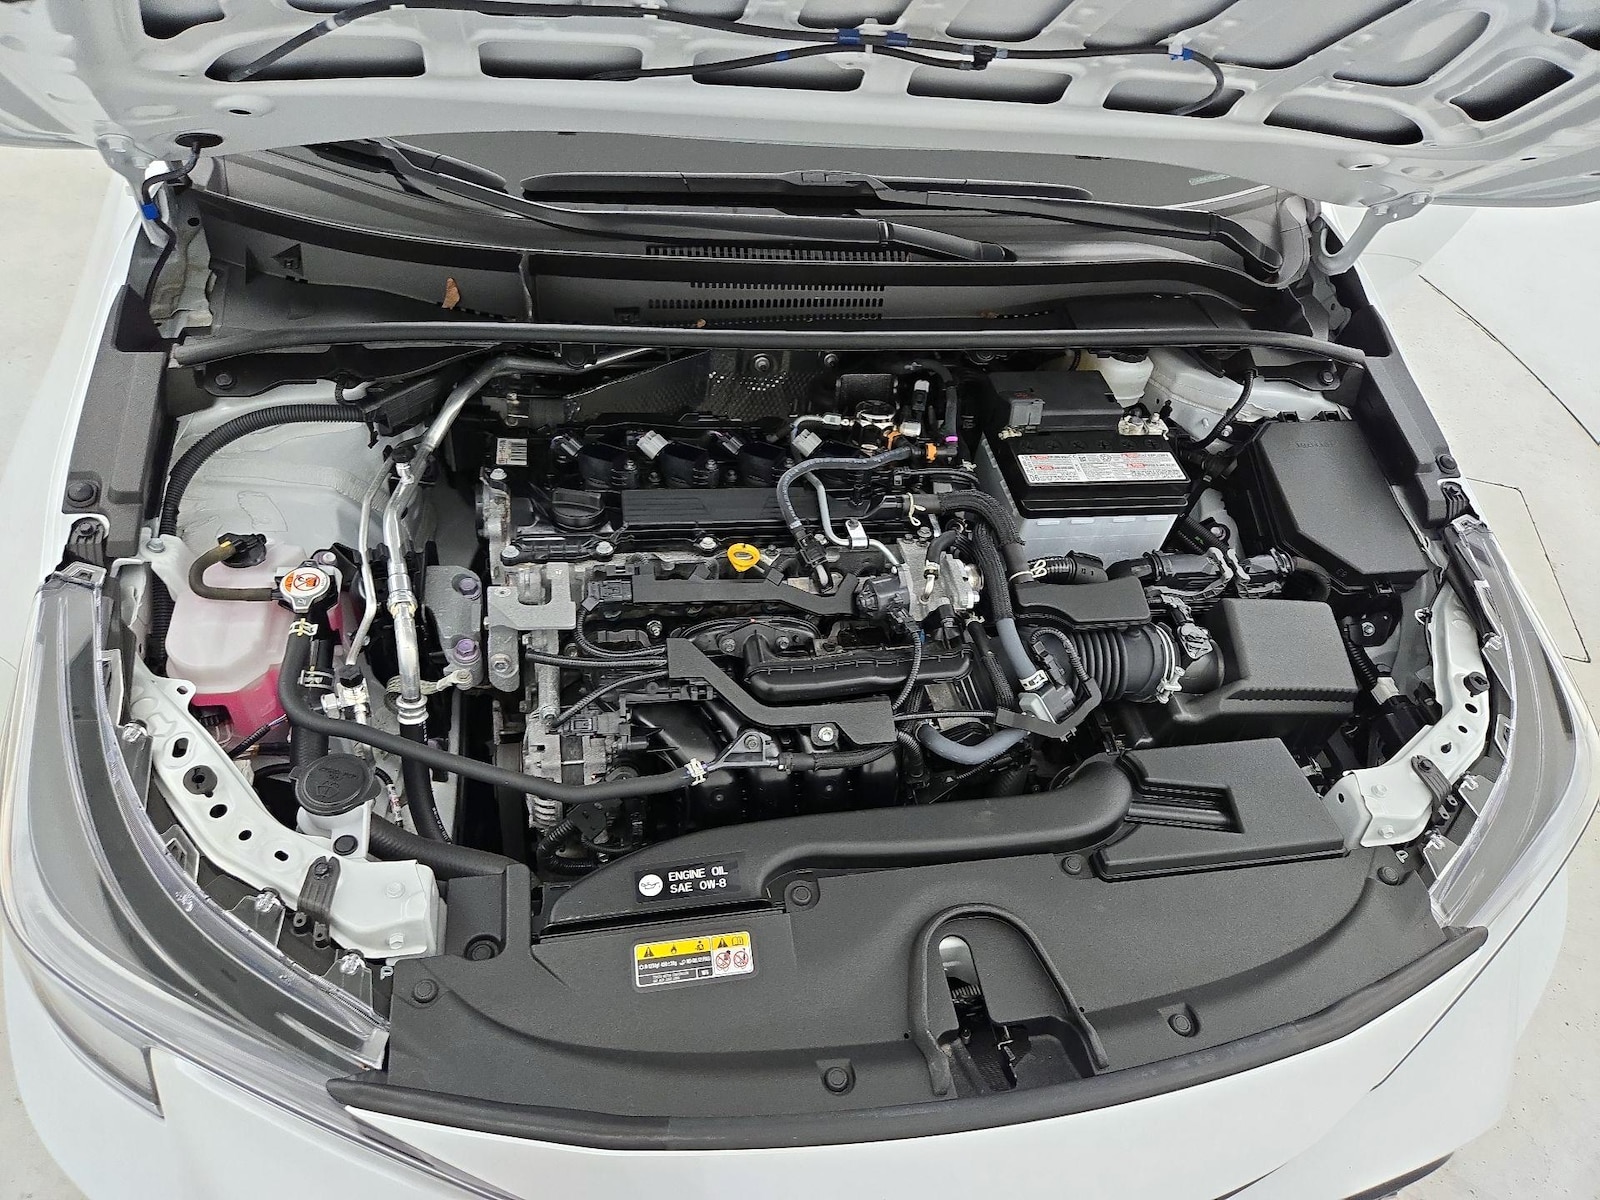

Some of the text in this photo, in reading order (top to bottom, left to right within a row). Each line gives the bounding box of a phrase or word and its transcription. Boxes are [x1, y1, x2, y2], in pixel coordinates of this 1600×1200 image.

[668, 866, 728, 881] ENGINE OIL
[670, 878, 727, 894] SAE 0W-8
